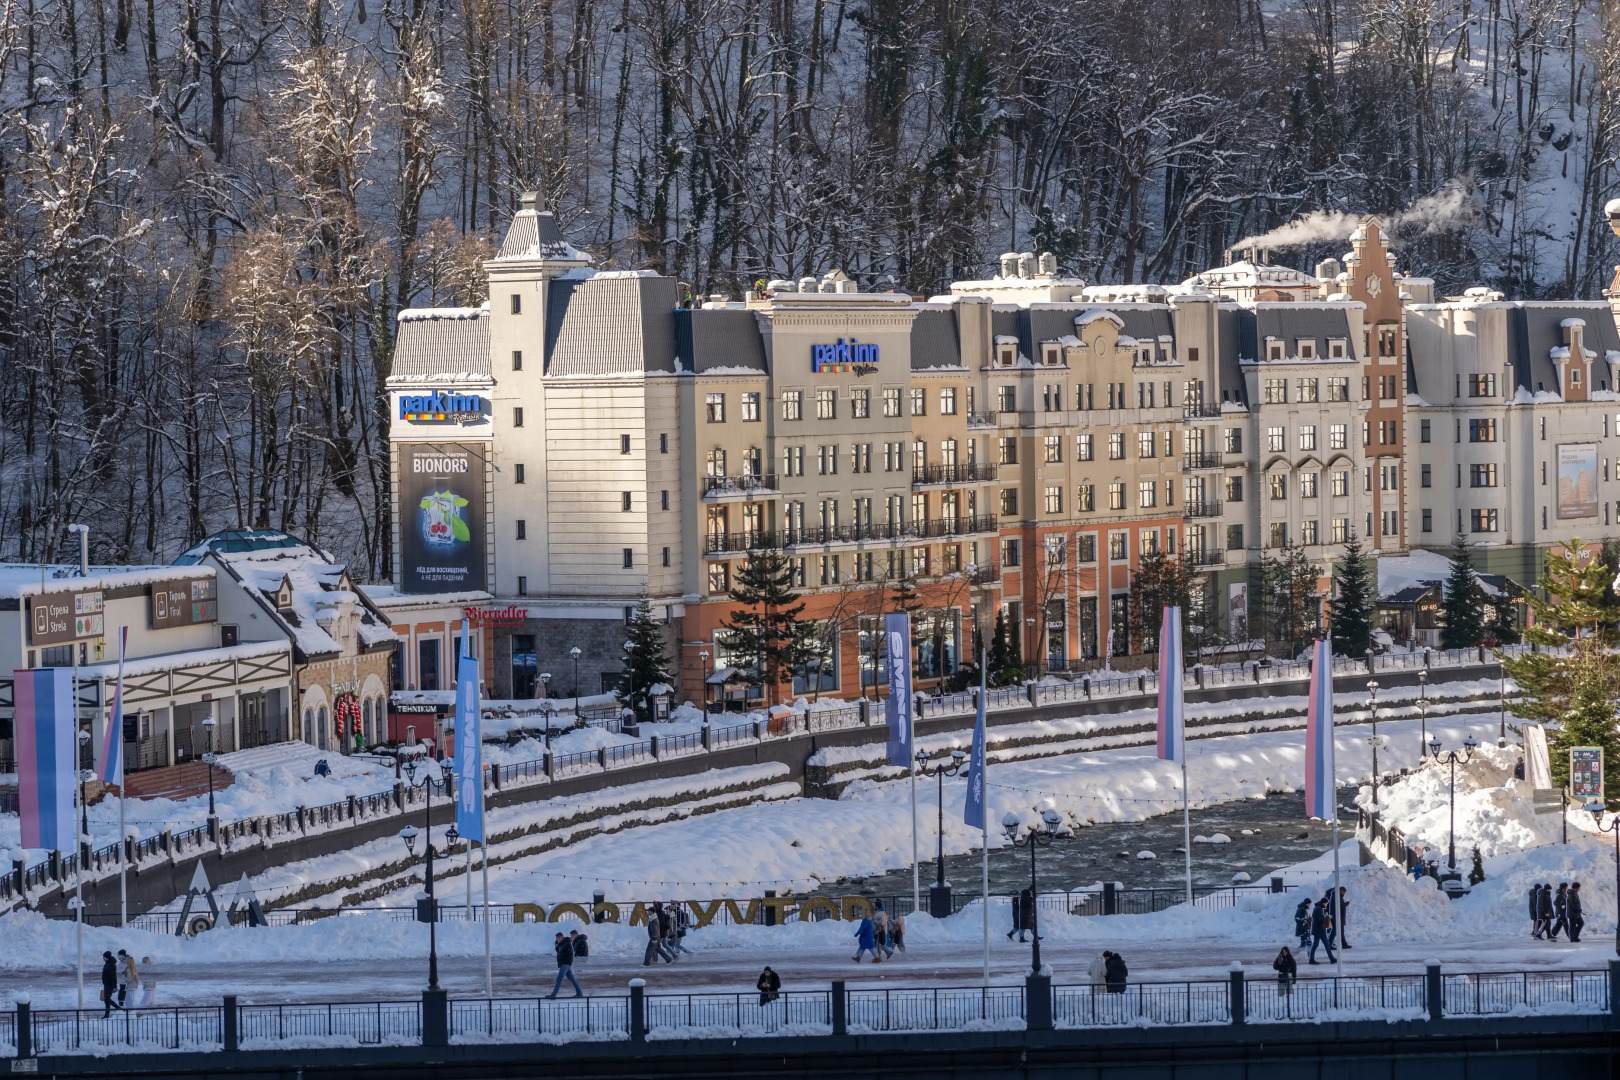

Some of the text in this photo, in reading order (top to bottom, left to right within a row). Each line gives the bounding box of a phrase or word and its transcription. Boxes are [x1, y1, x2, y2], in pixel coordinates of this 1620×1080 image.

[812, 337, 879, 373] park inn
[399, 389, 480, 420] park inn
[413, 458, 468, 473] BIONORD
[169, 590, 187, 602] Тироль
[50, 604, 69, 616] Стрела
[169, 606, 182, 618] Tirol
[463, 605, 528, 621] Bierkeller
[50, 621, 67, 633] Strela
